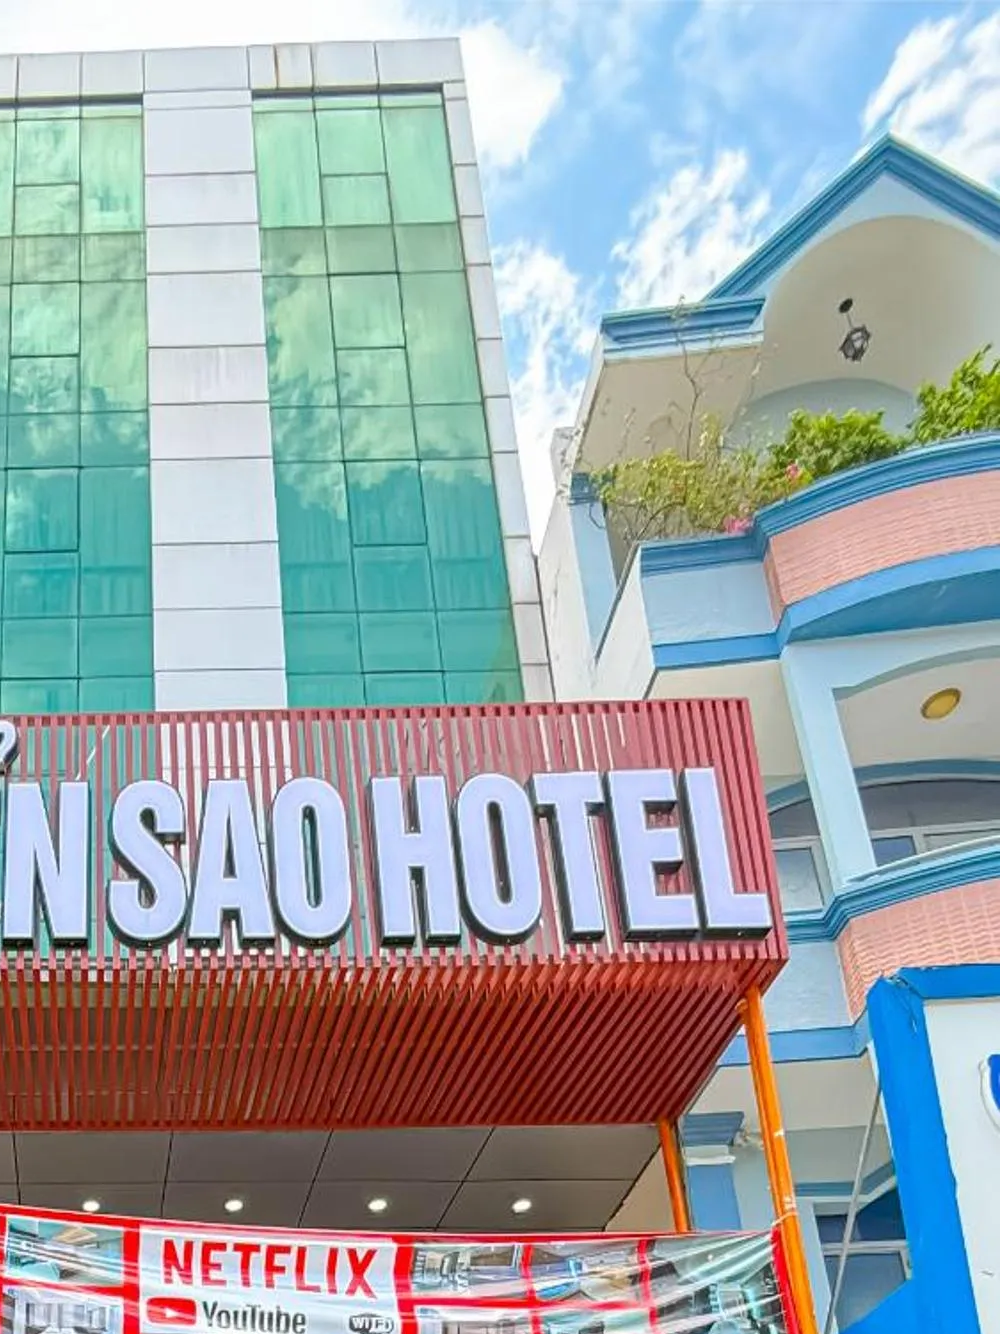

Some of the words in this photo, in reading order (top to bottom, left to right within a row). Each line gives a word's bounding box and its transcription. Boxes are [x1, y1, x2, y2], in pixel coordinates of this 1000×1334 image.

[106, 779, 351, 947] SAO
[370, 767, 773, 947] HOTEL
[163, 1239, 378, 1300] NETFLIX
[203, 1300, 306, 1334] YouTube
